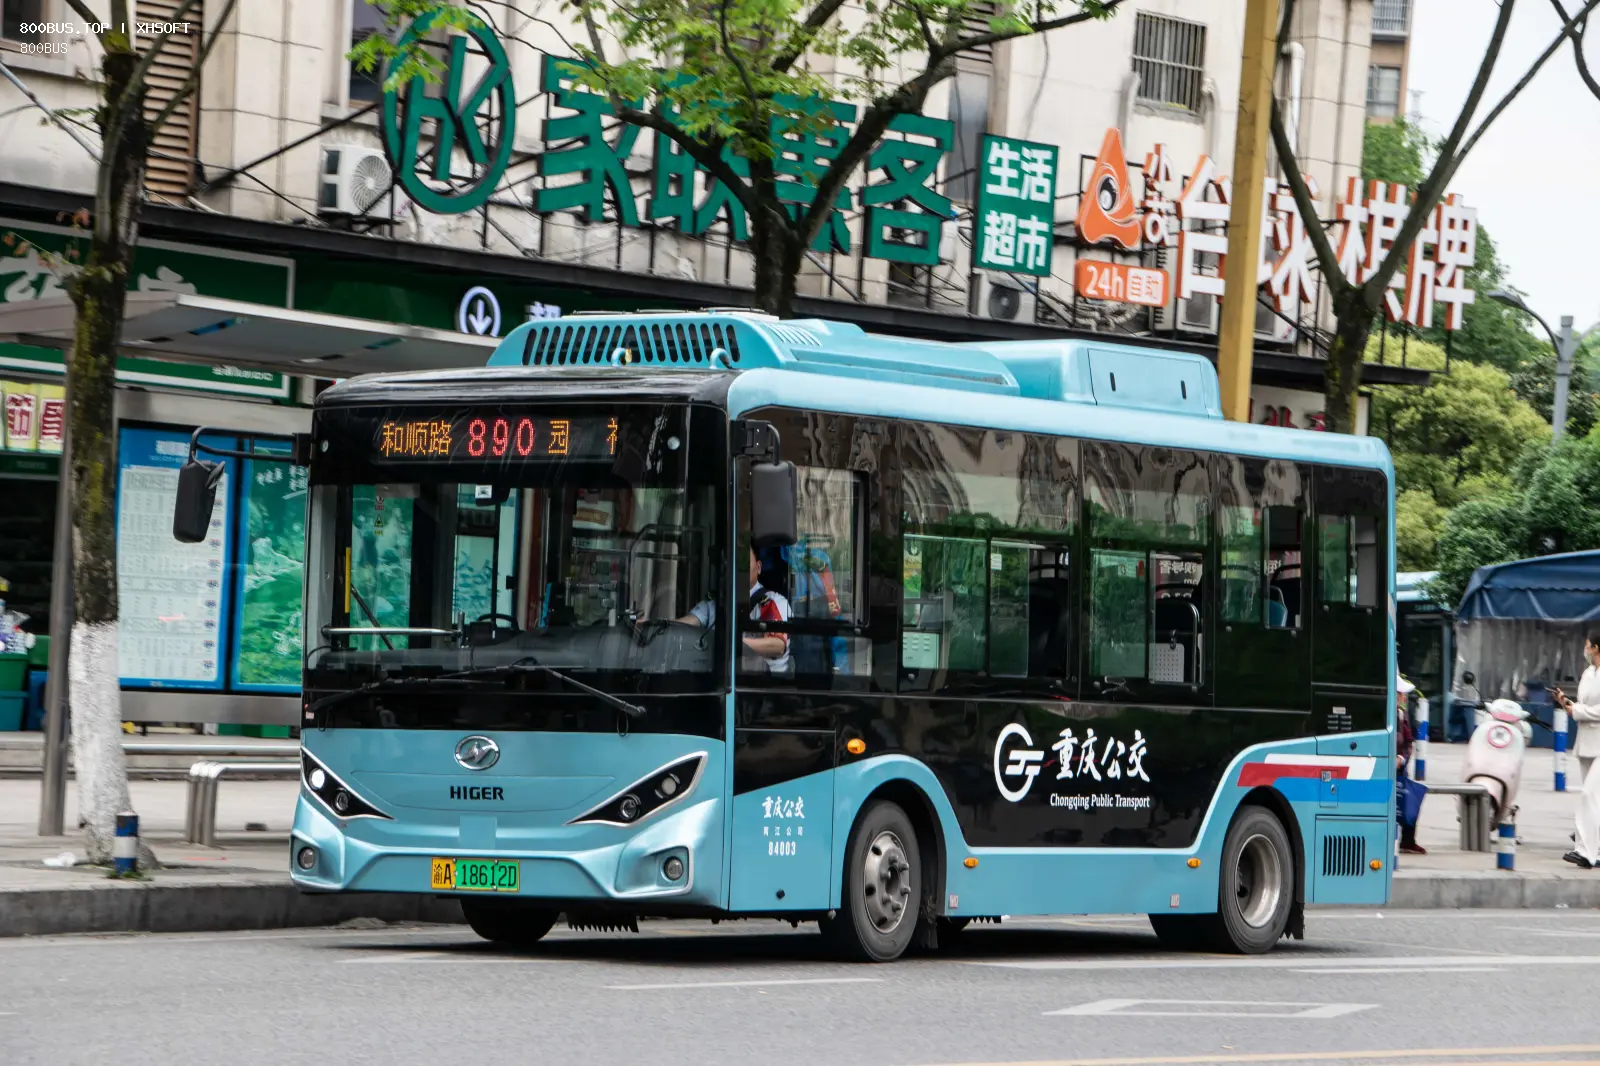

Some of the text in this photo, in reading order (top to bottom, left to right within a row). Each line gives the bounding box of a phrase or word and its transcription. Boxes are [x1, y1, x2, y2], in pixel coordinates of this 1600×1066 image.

[986, 141, 1053, 204] 生活
[981, 210, 1050, 270] 超市
[1085, 265, 1124, 299] 24h
[381, 420, 451, 457] 和顺路
[468, 419, 535, 456] 890
[1052, 728, 1150, 782] 重庆公交
[450, 786, 504, 800] HIGER
[762, 796, 805, 819] 重庆公交
[1050, 793, 1150, 811] Chongqing Public Transport
[768, 841, 796, 856] 84003
